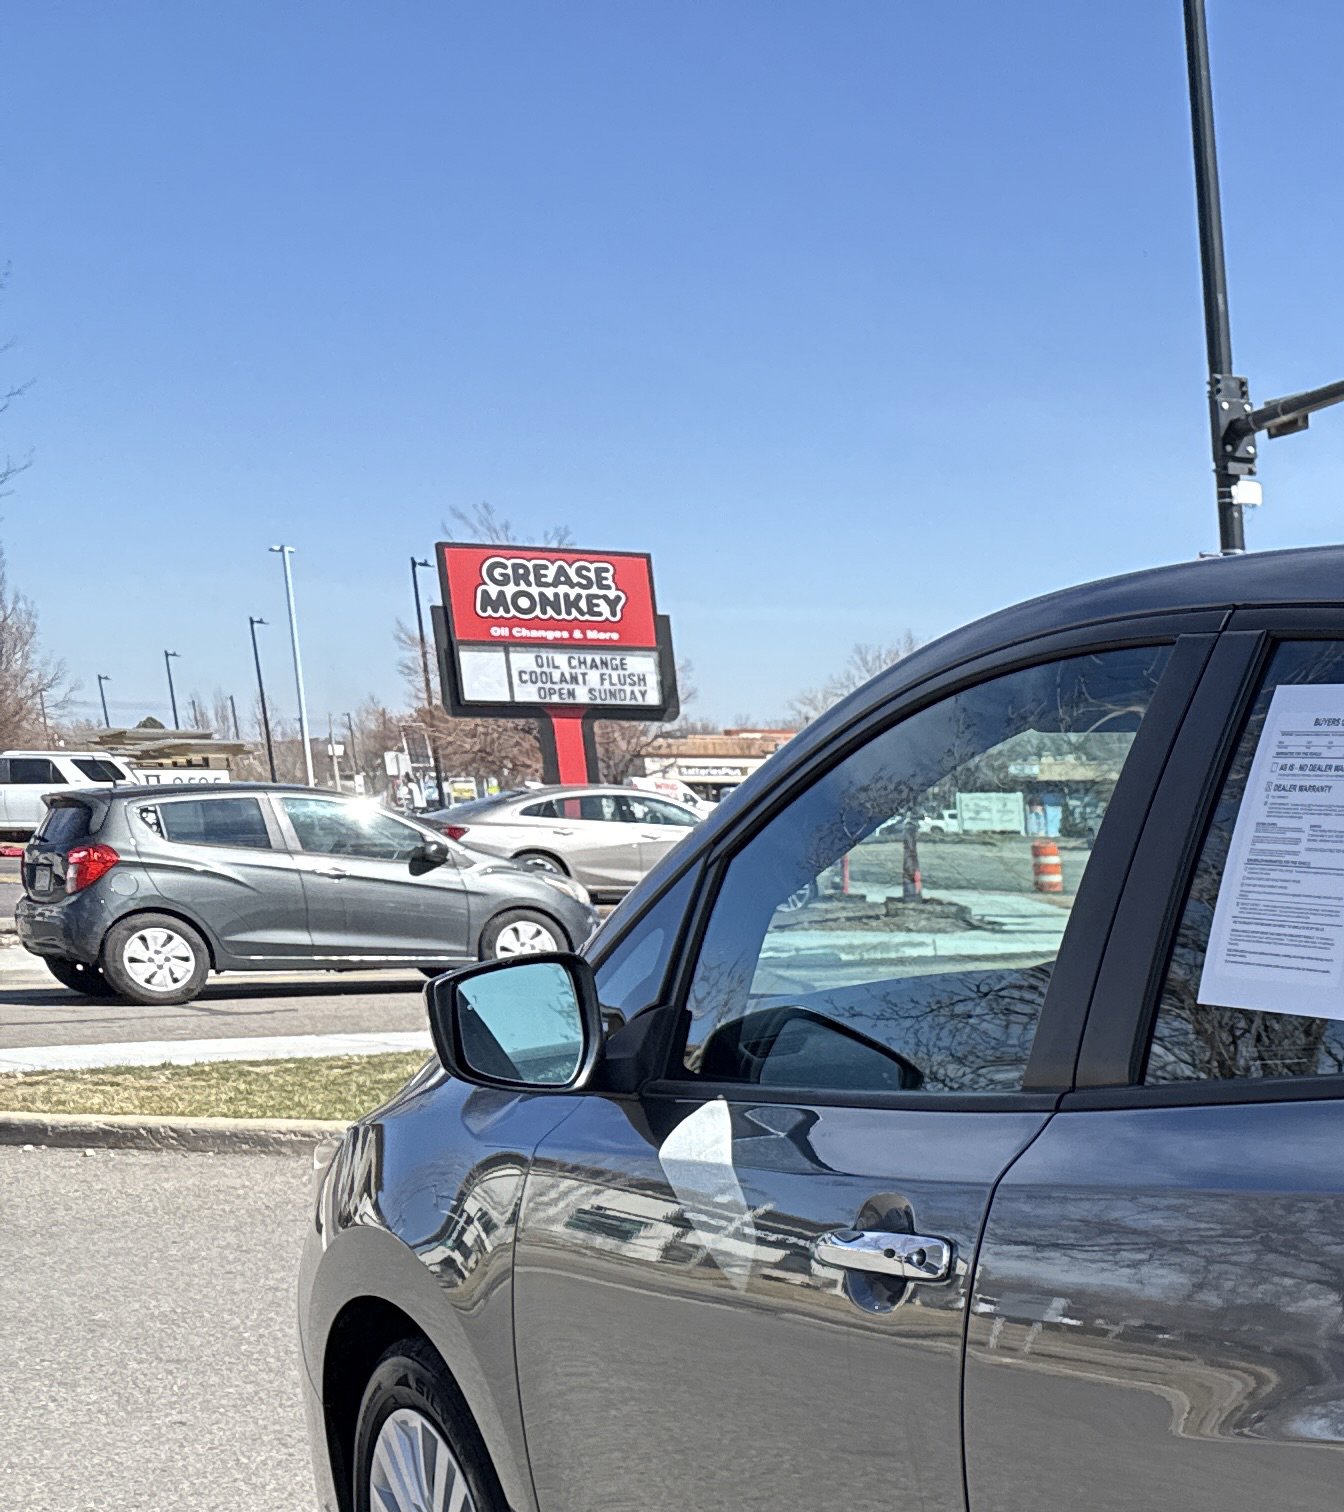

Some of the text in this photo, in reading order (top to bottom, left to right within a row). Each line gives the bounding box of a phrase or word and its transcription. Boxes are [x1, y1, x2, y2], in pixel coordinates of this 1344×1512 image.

[485, 560, 613, 591] GREASE
[479, 588, 623, 618] MONKEY
[490, 626, 620, 641] Oil Changes & More
[534, 654, 628, 671] OIL CHANGE
[518, 669, 648, 688] COOLANT FLUSH
[537, 686, 648, 703] OPEN SUNDAY
[1313, 717, 1341, 727] BUYERS
[1298, 764, 1308, 772] NO
[1308, 764, 1333, 772] DEALER
[1273, 783, 1333, 794] DEALER WARRANTY
